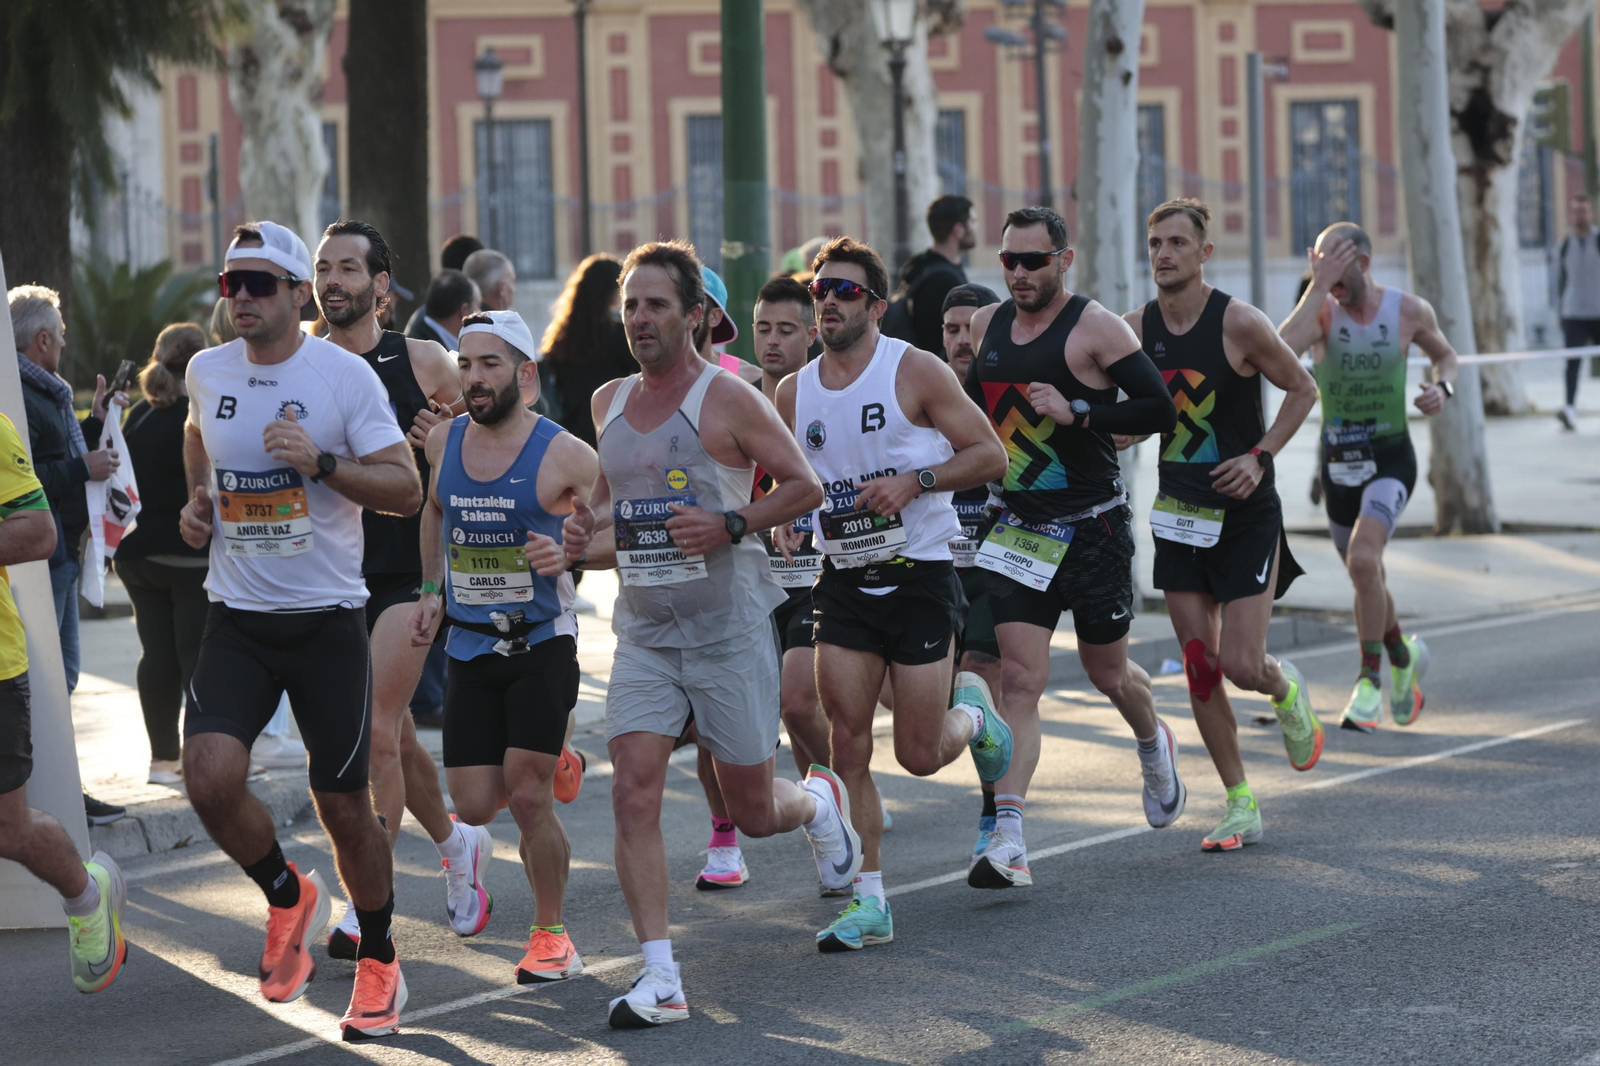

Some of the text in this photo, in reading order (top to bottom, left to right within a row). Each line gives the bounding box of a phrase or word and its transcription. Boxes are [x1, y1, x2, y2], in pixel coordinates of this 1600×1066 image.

[240, 473, 291, 490] ZURICH
[450, 494, 515, 509] Dantzaleku
[1177, 501, 1199, 513] 1360
[244, 504, 273, 517] 3737
[461, 510, 507, 522] Sakana
[842, 517, 872, 534] 2018
[1176, 518, 1194, 528] GUTI
[271, 524, 292, 536] VAZ
[467, 533, 515, 544] ZURICH
[637, 529, 668, 545] 2638
[840, 535, 886, 551] IRONMIND
[1013, 536, 1040, 554] 1358
[471, 557, 499, 569] 1170
[1003, 551, 1033, 569] CHOPO
[469, 576, 506, 587] CARLOS
